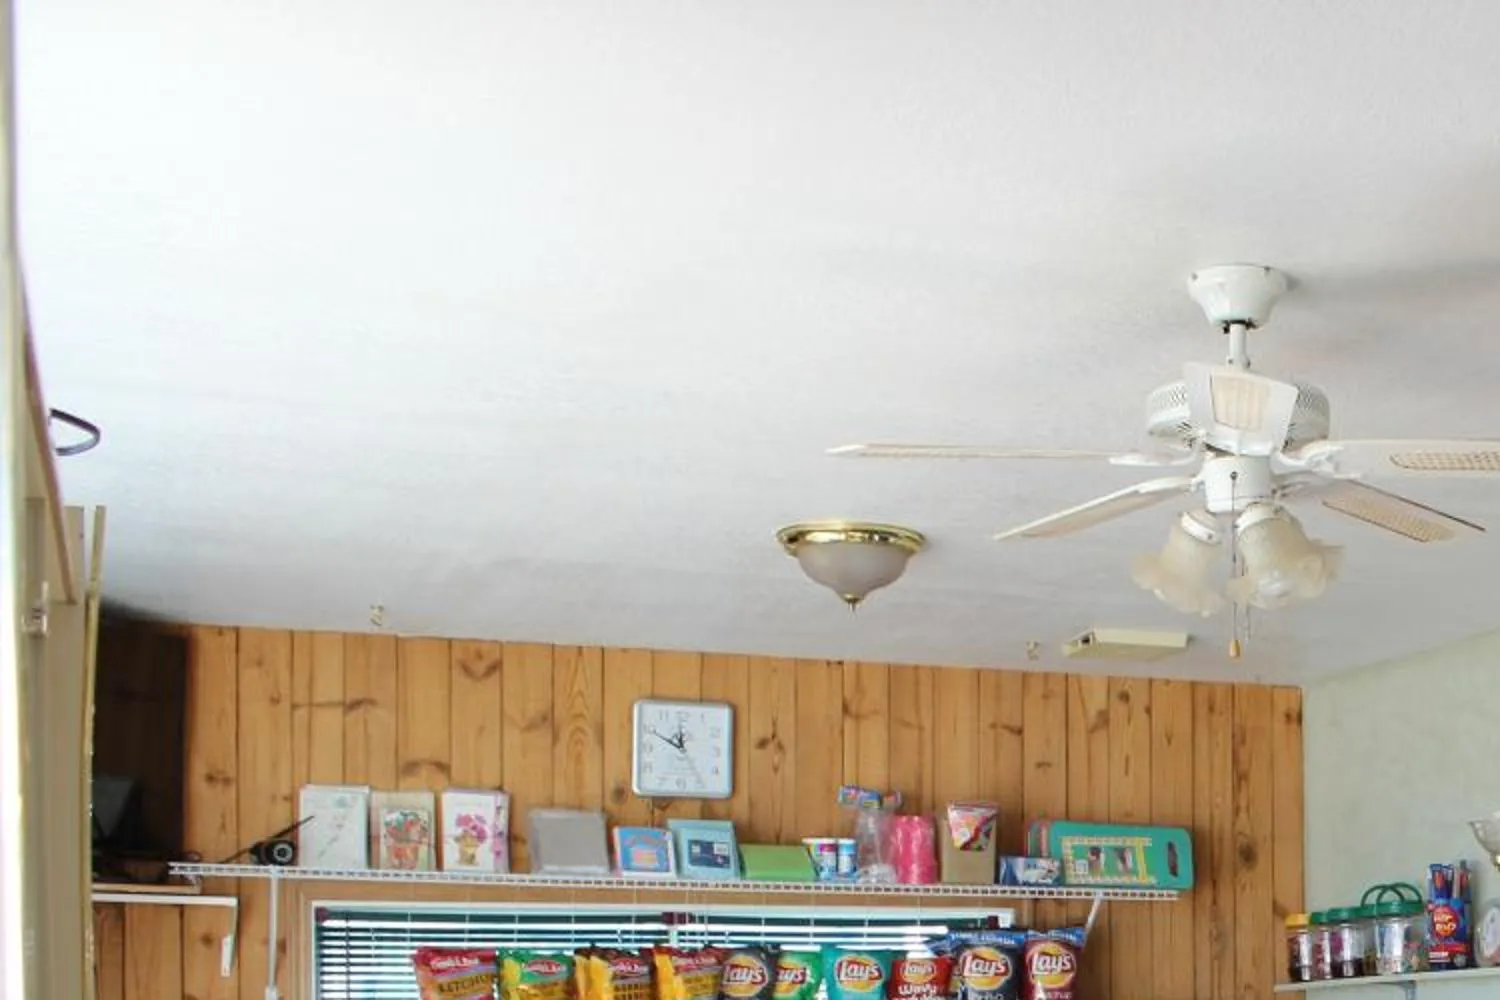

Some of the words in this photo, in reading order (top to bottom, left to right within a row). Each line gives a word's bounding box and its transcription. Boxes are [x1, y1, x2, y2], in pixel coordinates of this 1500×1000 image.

[724, 962, 764, 985] Lay's
[777, 966, 806, 984] ay's
[839, 959, 880, 982] Lay's
[962, 951, 1007, 977] Lay's
[1030, 951, 1073, 977] Lay's
